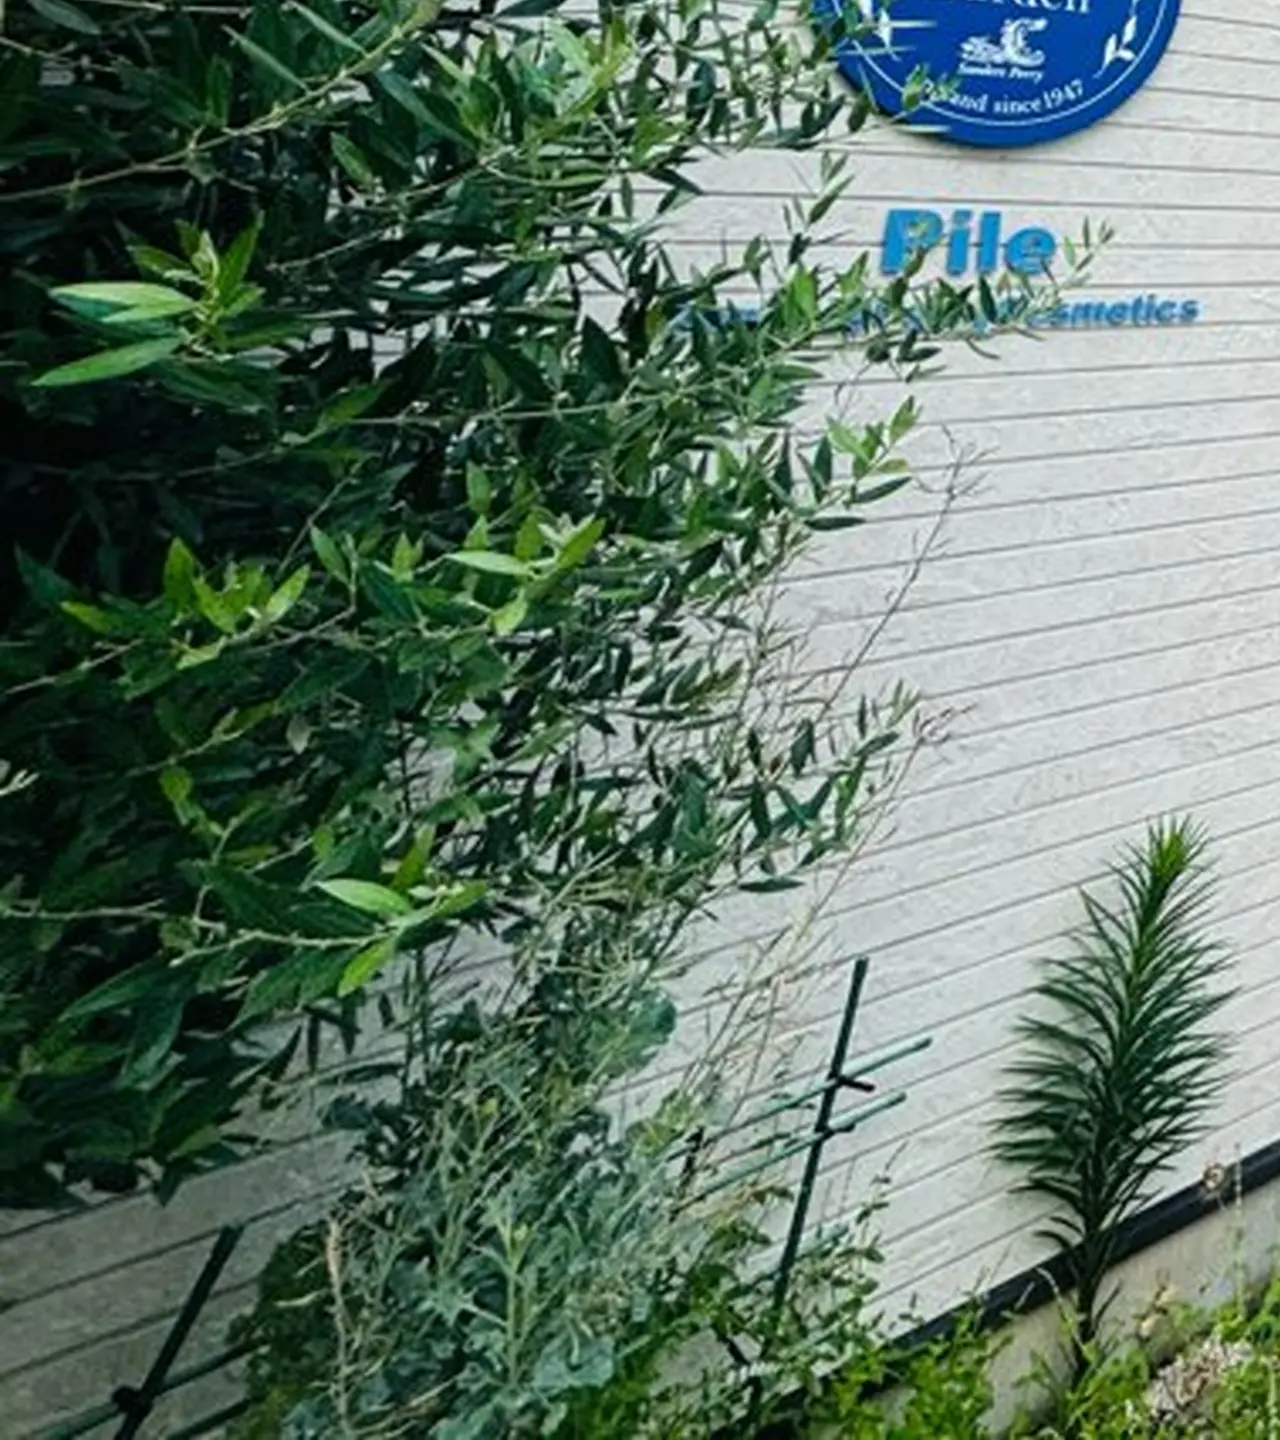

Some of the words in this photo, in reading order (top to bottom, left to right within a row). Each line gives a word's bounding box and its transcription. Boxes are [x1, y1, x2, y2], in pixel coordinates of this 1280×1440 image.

[992, 95, 1042, 113] since
[1042, 78, 1084, 110] 1947
[879, 207, 1058, 277] Pile
